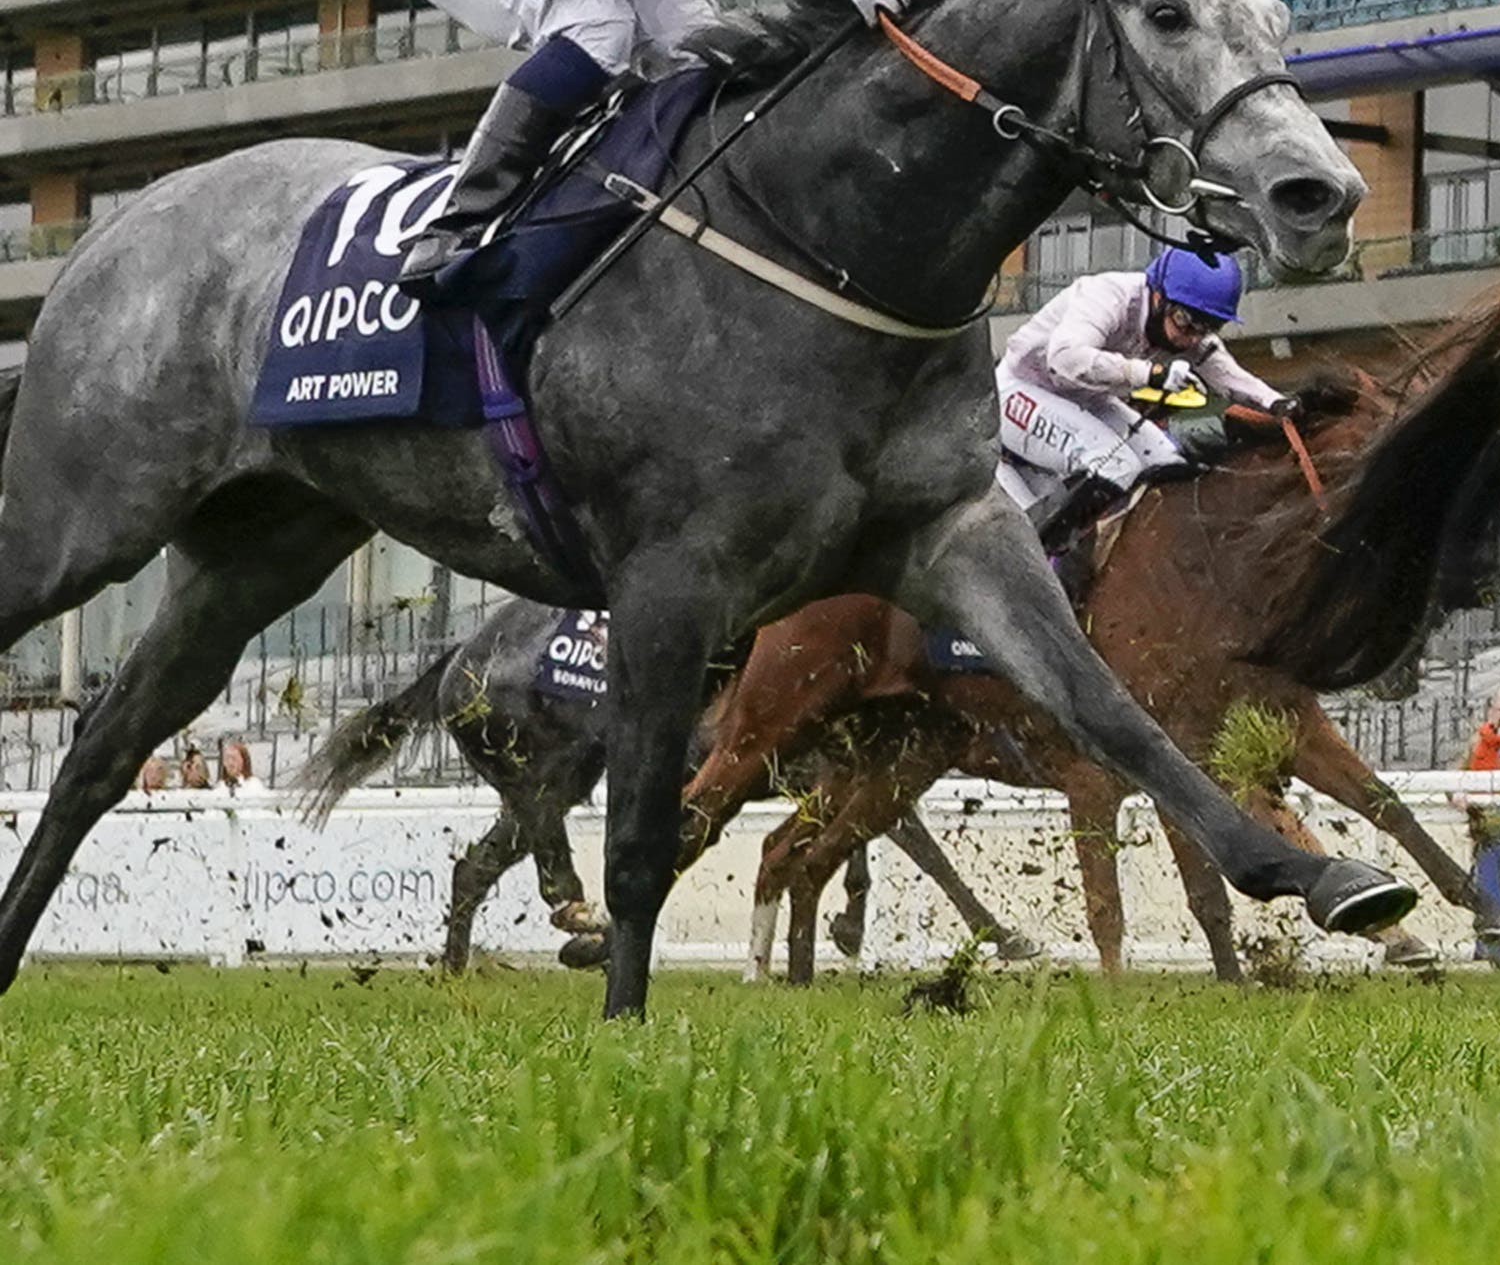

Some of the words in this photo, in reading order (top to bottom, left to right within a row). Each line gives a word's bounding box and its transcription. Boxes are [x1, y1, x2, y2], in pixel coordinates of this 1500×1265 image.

[327, 165, 460, 267] 10
[280, 280, 421, 348] QIPCO
[286, 374, 325, 402] ART
[328, 370, 398, 400] POWER
[1031, 415, 1074, 453] BET
[549, 635, 606, 670] QIPC
